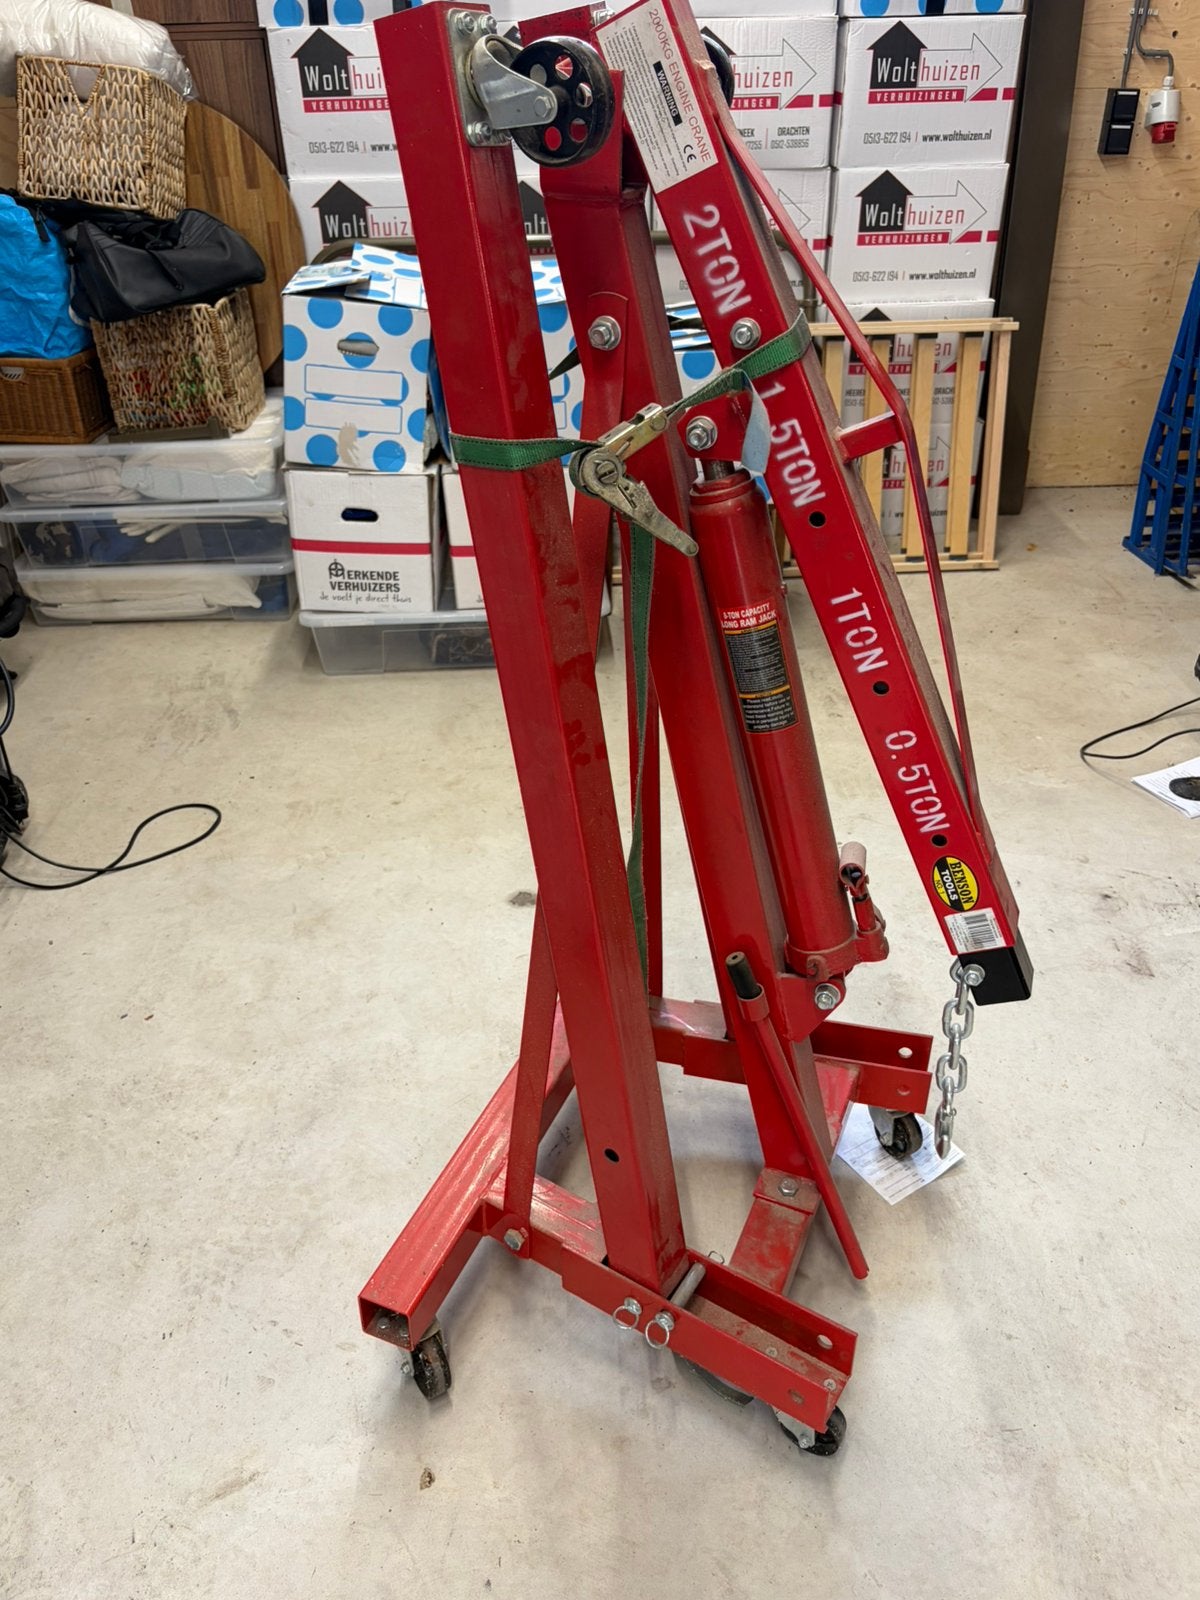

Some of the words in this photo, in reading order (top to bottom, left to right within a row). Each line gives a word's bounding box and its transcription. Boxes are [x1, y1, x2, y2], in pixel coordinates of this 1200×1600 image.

[877, 57, 980, 83] Wolthuizen
[649, 8, 674, 63] 2000KG
[668, 59, 694, 115] ENGINE
[688, 115, 712, 163] CRANE
[657, 69, 679, 118] WARNING
[876, 90, 957, 102] VERHUIZINGEN
[777, 126, 810, 137] DRACHTEN
[922, 129, 992, 142] www.wolthuizen.nl
[865, 203, 964, 227] Wolthuizen
[865, 233, 942, 245] VERHUIZINGEN
[682, 203, 752, 316] 2TON
[759, 380, 826, 508] 15TON
[329, 581, 400, 593] VERHUIZERS
[347, 570, 400, 581] ERKENDE
[365, 593, 389, 603] direct
[740, 602, 770, 618] CAPACITY
[720, 620, 739, 629] LONG
[740, 616, 757, 627] RAM
[758, 609, 776, 623] JACK
[830, 586, 890, 674] 1TON
[884, 728, 951, 834] 0.5TON
[941, 869, 958, 901] TOOLS
[949, 861, 975, 904] BENSON
